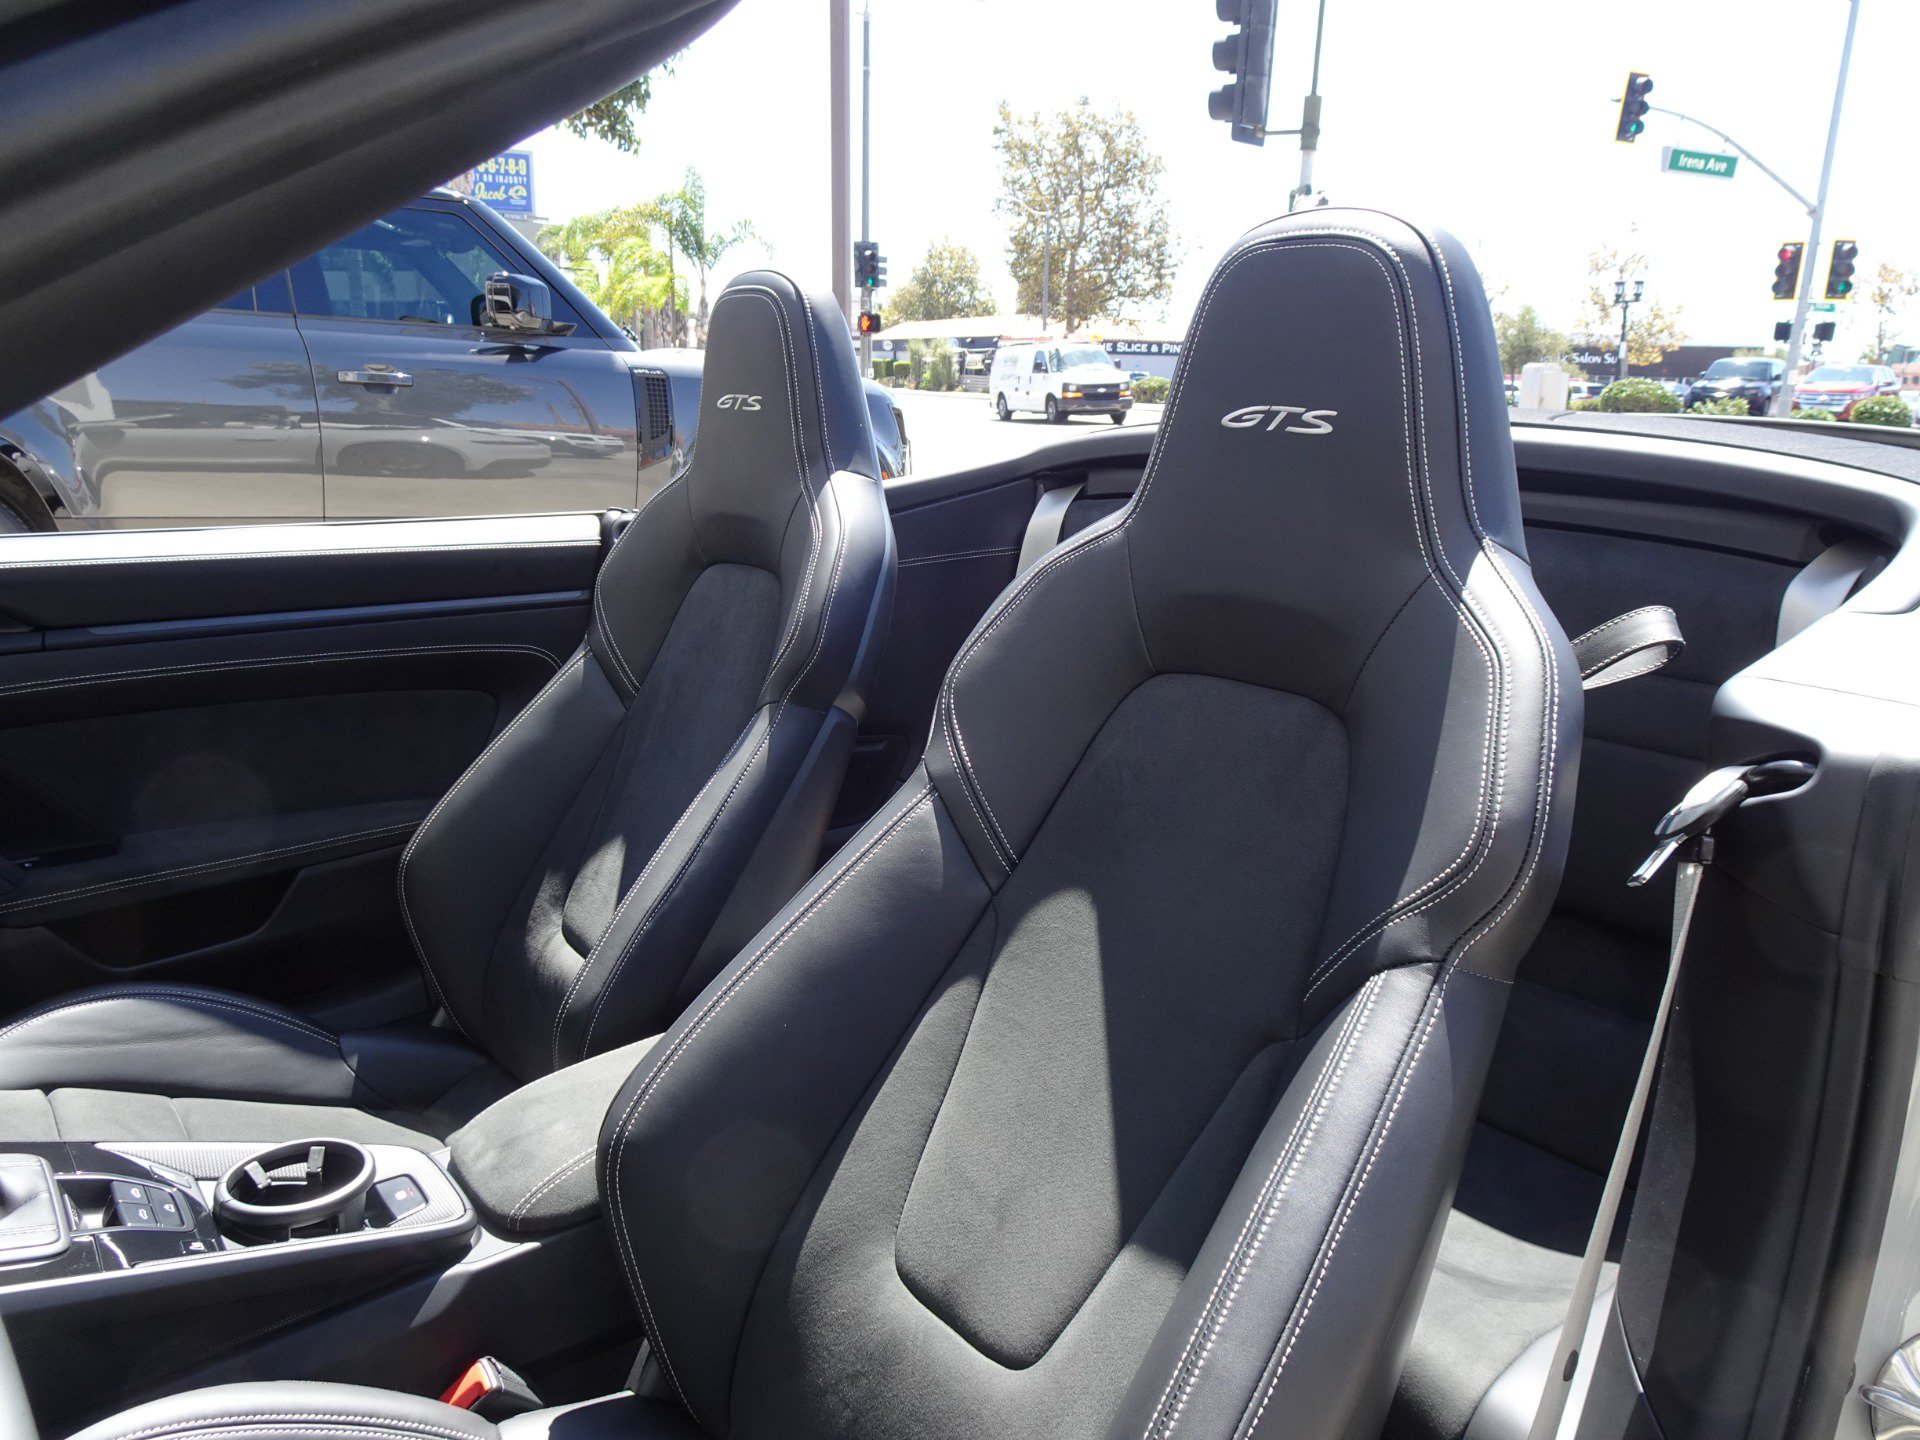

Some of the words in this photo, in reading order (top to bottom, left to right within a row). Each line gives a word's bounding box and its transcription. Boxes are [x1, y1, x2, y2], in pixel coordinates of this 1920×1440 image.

[1678, 154, 1705, 170] Irena
[1705, 157, 1728, 173] Ave
[474, 181, 508, 201] Jacob
[1117, 341, 1148, 353] SLICE
[1150, 345, 1159, 353] &
[716, 393, 763, 411] GTS
[1220, 405, 1338, 435] GTS
